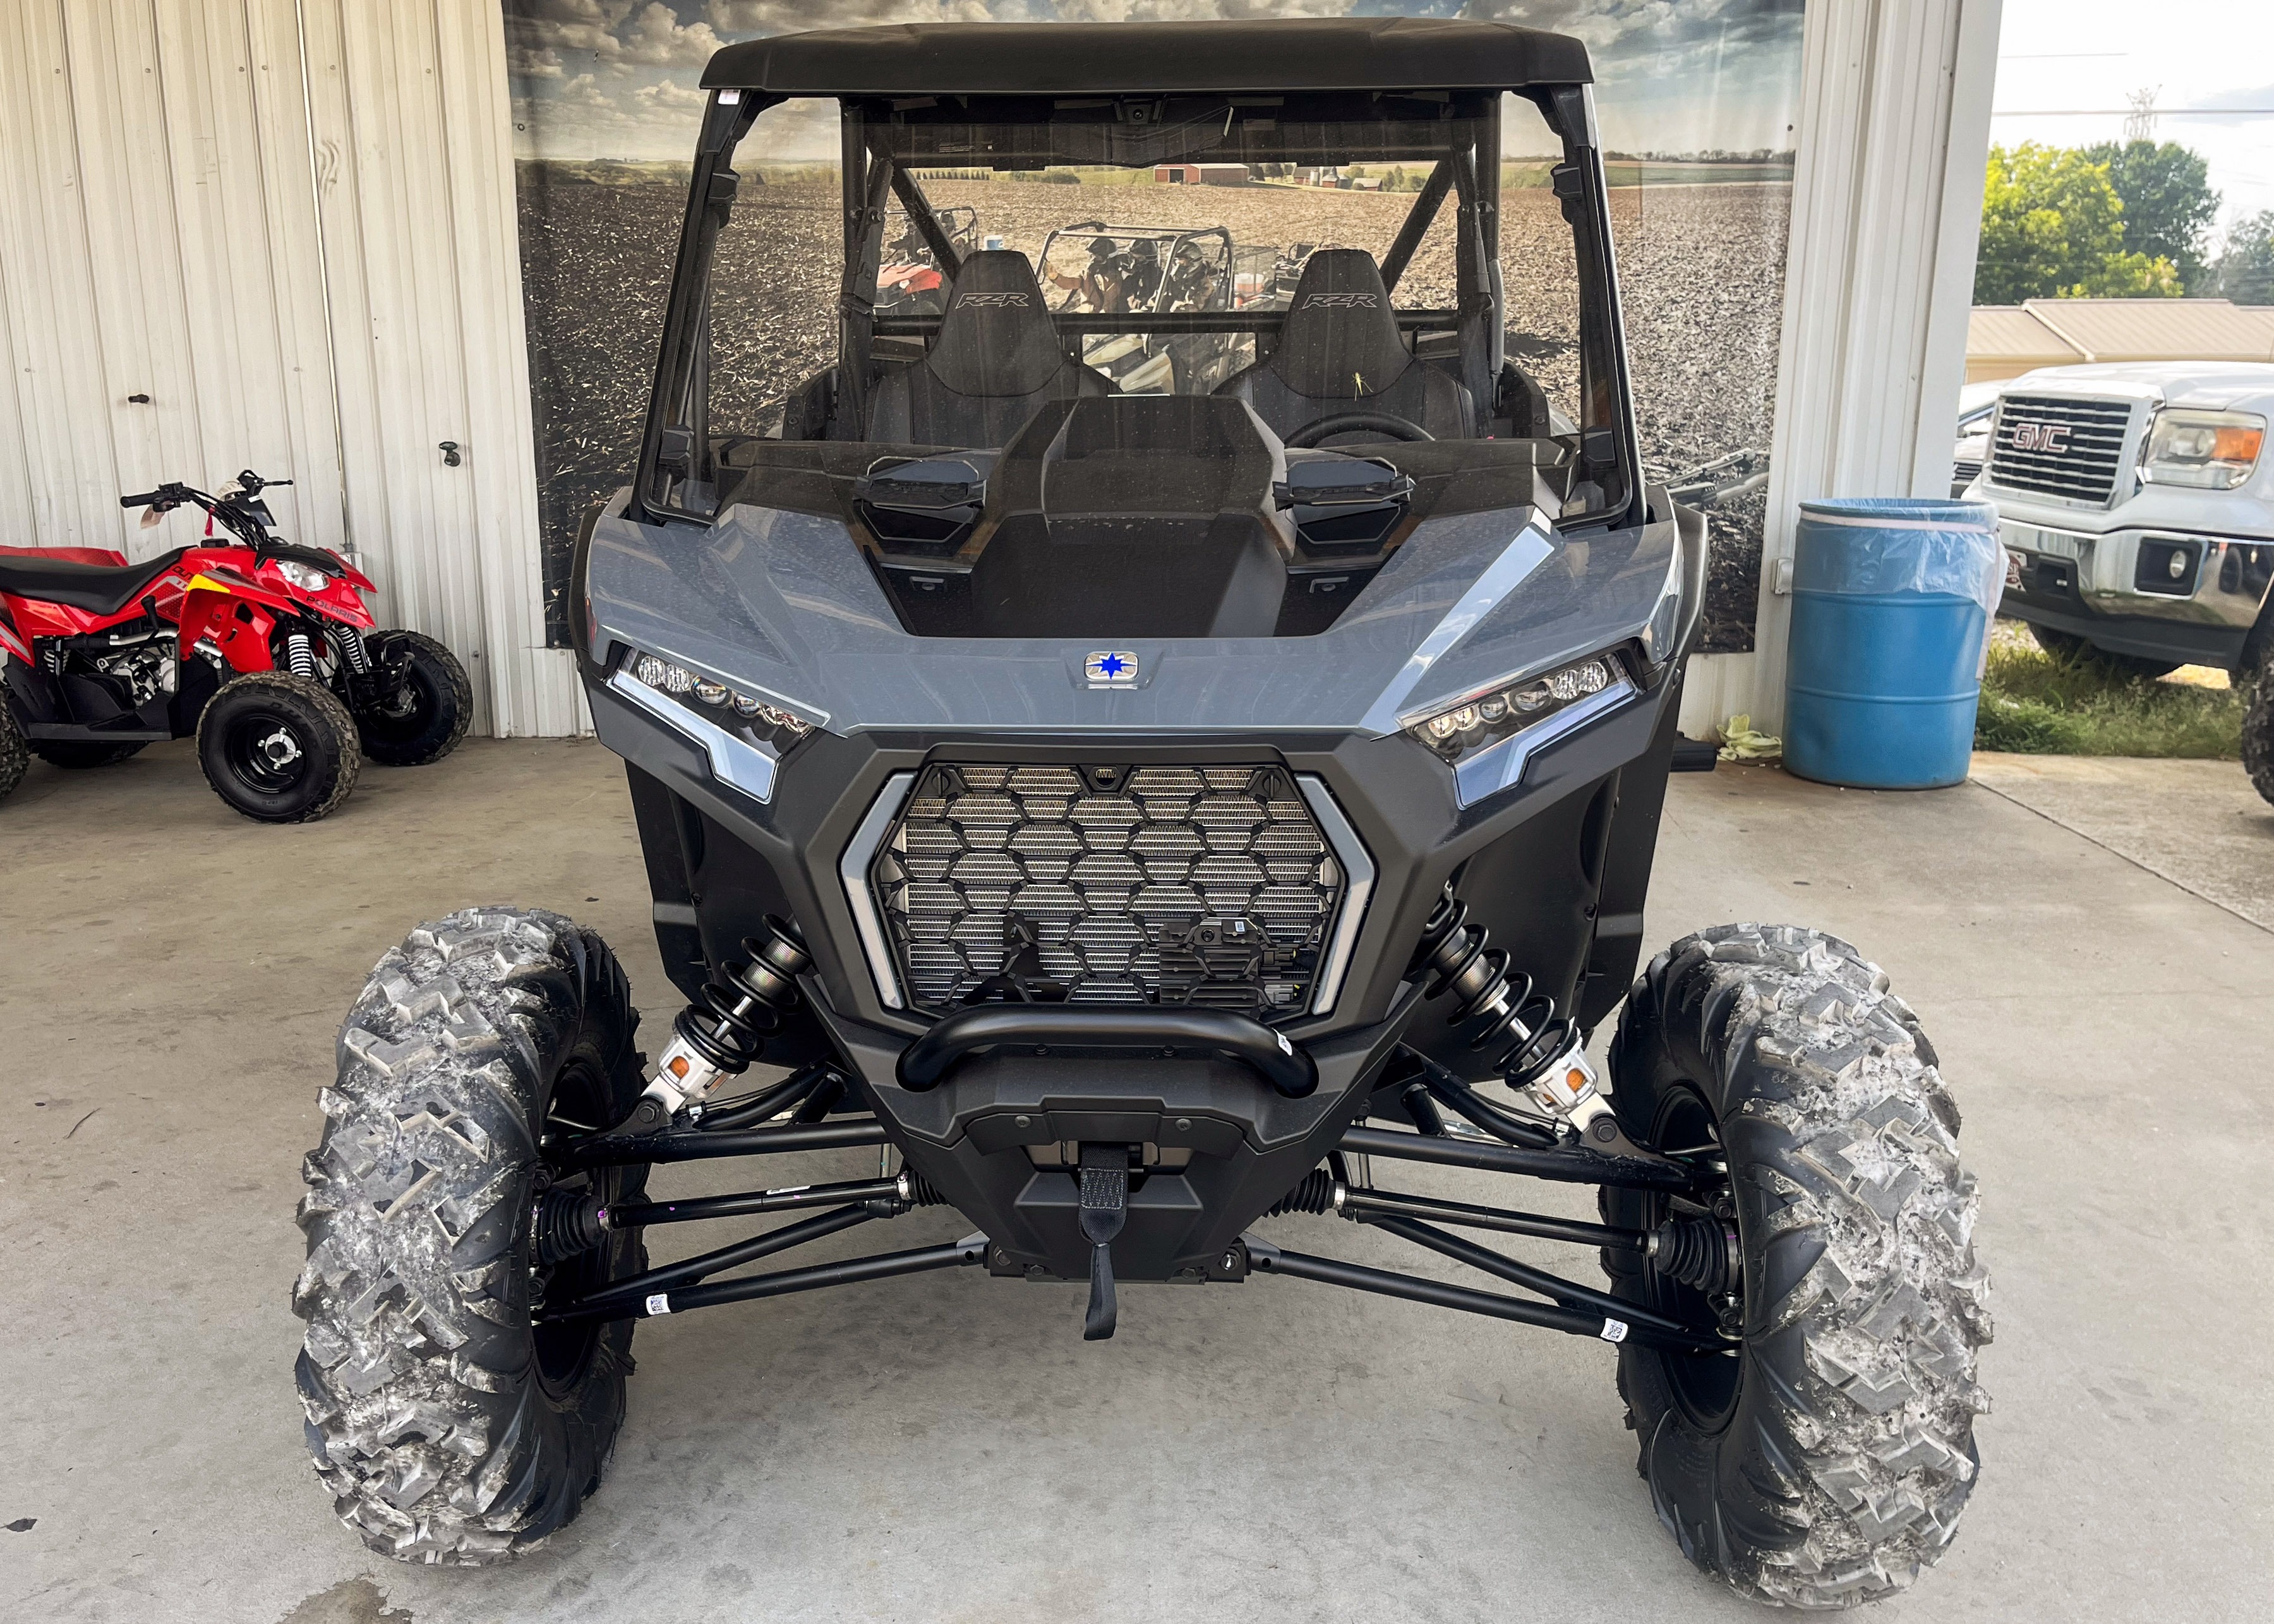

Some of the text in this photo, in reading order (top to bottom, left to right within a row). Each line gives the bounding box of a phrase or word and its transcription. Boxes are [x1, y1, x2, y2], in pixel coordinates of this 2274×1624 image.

[955, 292, 1029, 309] RZR
[1301, 293, 1378, 309] RZR
[2012, 423, 2071, 454] GMC
[172, 565, 196, 580] OUT
[306, 596, 358, 622] POLARIS
